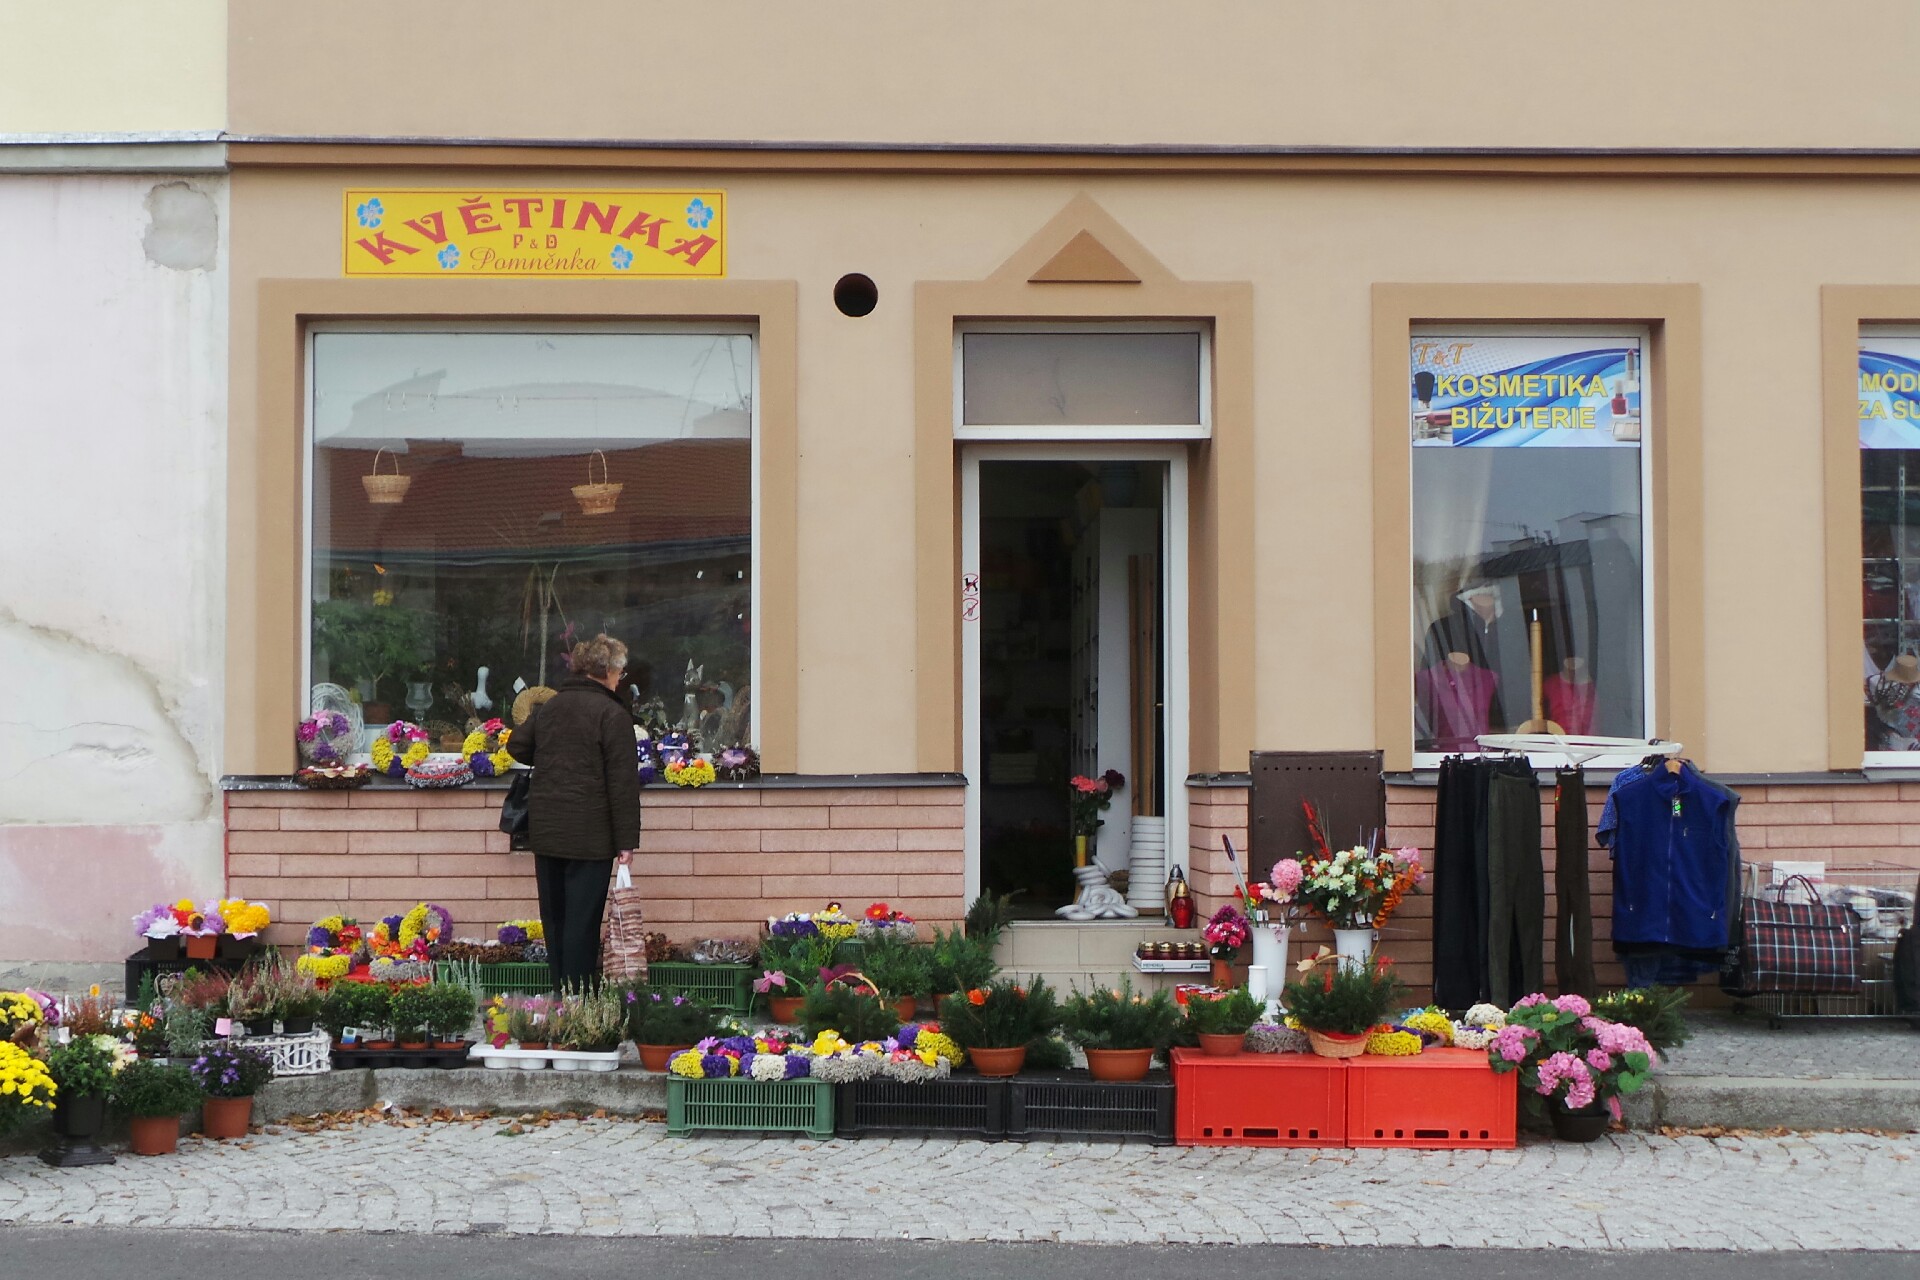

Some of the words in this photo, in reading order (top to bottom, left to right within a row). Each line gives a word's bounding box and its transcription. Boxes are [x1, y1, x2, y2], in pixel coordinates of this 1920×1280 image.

[355, 195, 718, 267] KVĚTINKA
[513, 234, 523, 249] P
[529, 239, 538, 249] &
[469, 246, 601, 271] Pomněnka
[1437, 374, 1608, 398] KOSMETIKA
[1862, 368, 1920, 393] MÓD
[1451, 402, 1596, 429] BIŽUTERIE
[1857, 400, 1887, 420] ZA
